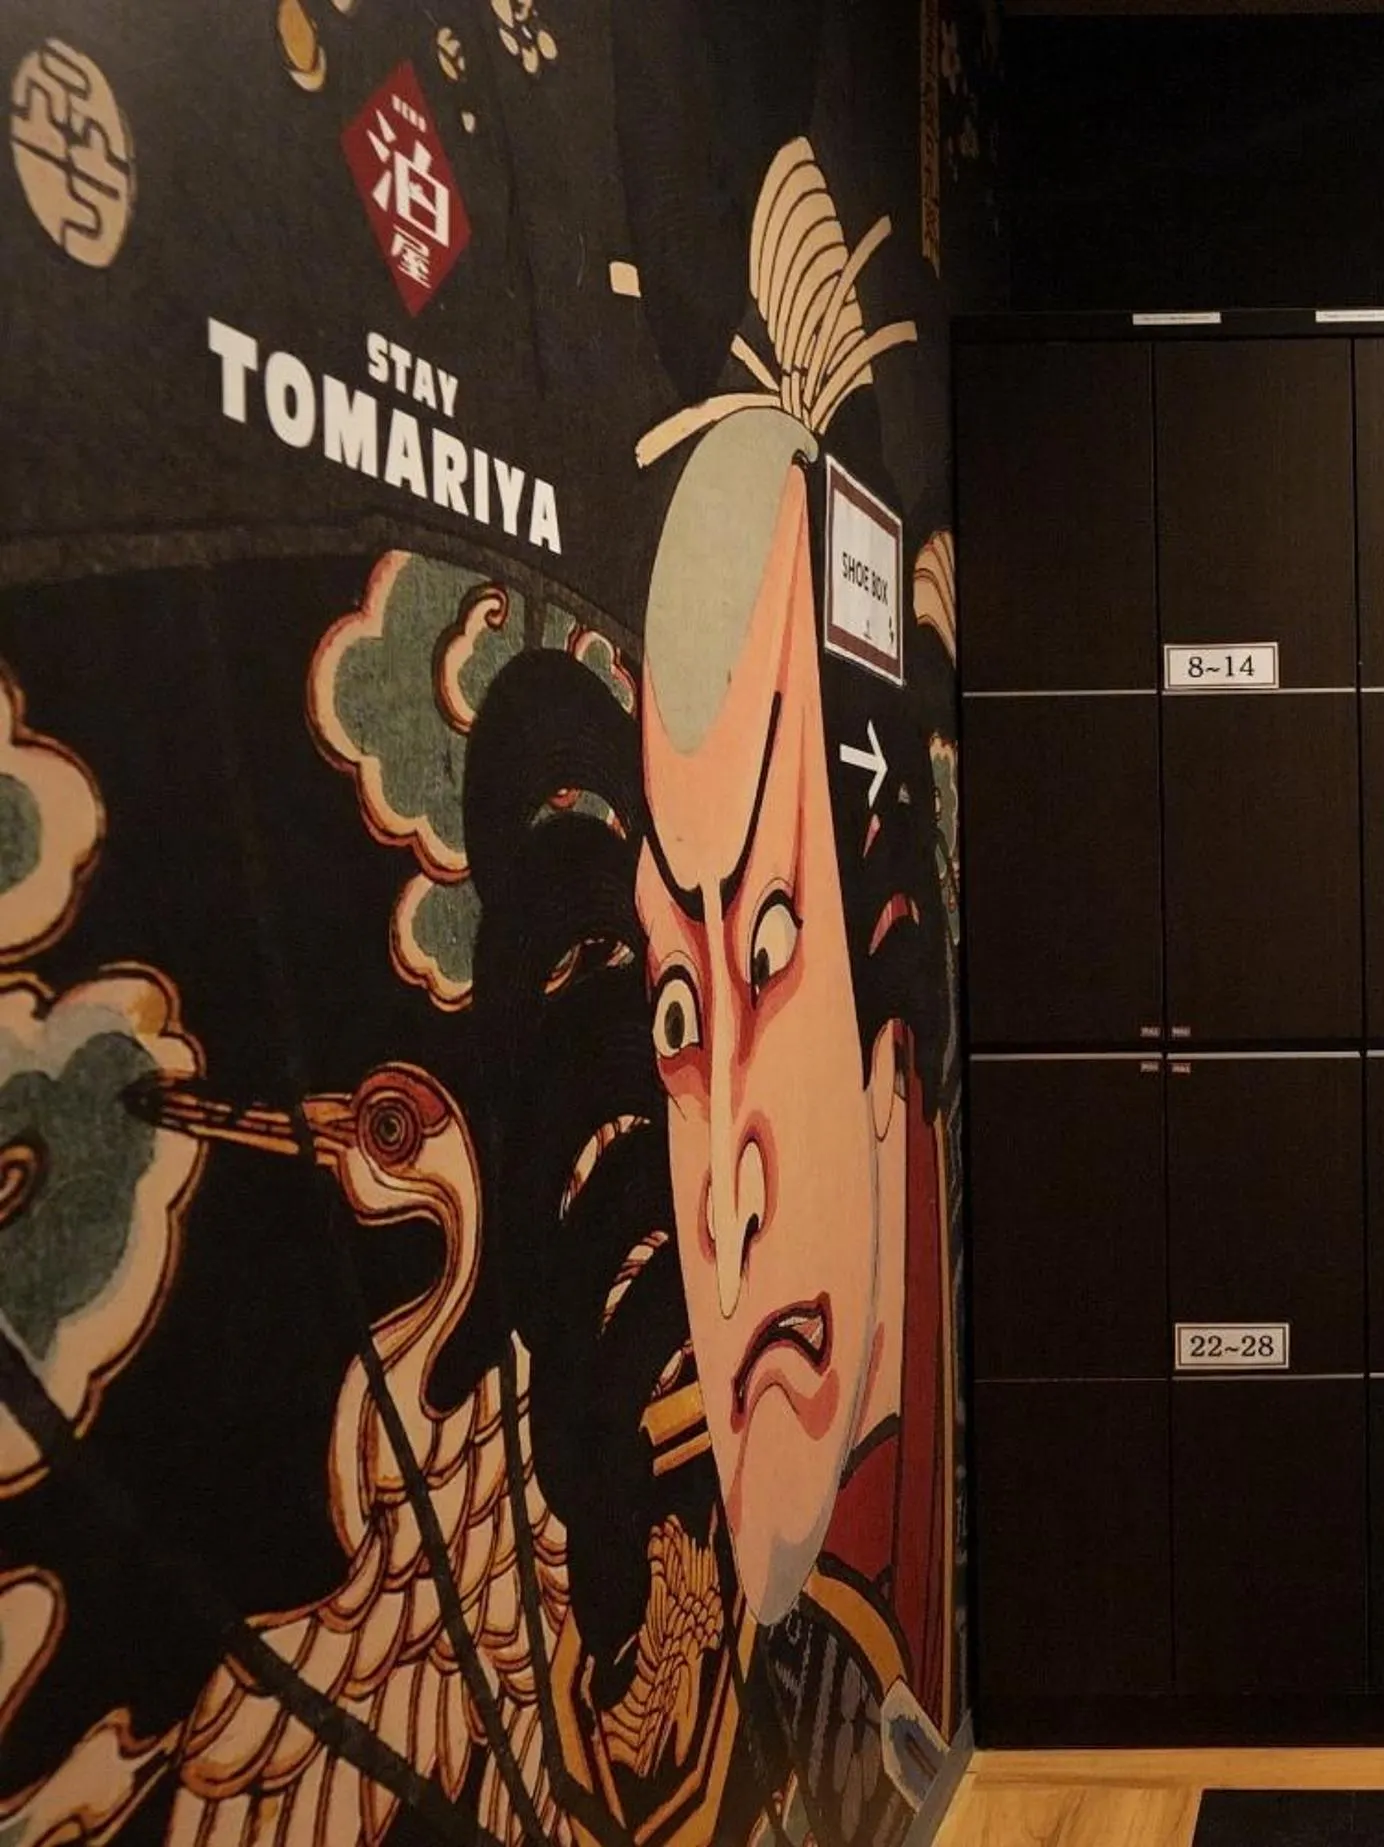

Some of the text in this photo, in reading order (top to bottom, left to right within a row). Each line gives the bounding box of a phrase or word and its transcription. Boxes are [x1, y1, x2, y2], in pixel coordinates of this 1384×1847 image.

[366, 331, 459, 419] STAY
[208, 316, 563, 555] TOMARIYA
[841, 551, 889, 607] SHOE BOX
[1188, 654, 1255, 679] 8~14
[1189, 1335, 1274, 1357] 22~28
